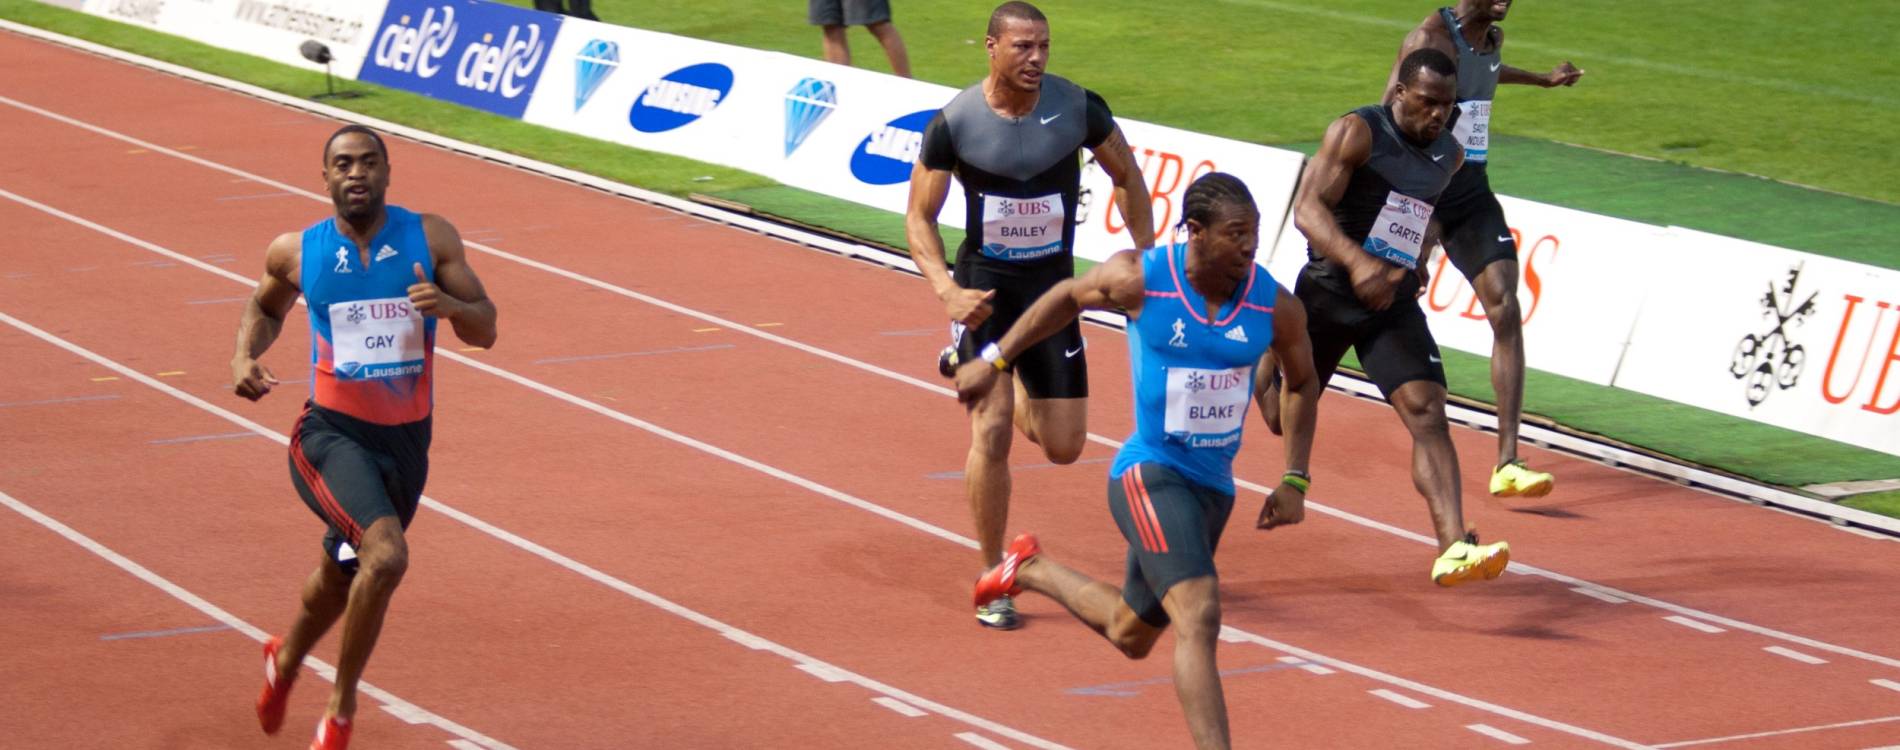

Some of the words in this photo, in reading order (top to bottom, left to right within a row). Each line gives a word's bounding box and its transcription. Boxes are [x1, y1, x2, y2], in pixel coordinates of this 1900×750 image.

[641, 79, 721, 117] SAMSUNG
[864, 124, 923, 164] SAMS
[1017, 200, 1051, 215] UBS
[1000, 225, 1048, 238] BAILEY
[1008, 244, 1061, 259] Lausanne
[369, 301, 410, 320] UBS
[364, 334, 396, 350] GAY
[1822, 293, 1900, 415] UB
[364, 363, 424, 379] Lausanne
[1209, 371, 1242, 391] UBS
[1188, 404, 1235, 420] BLAKE
